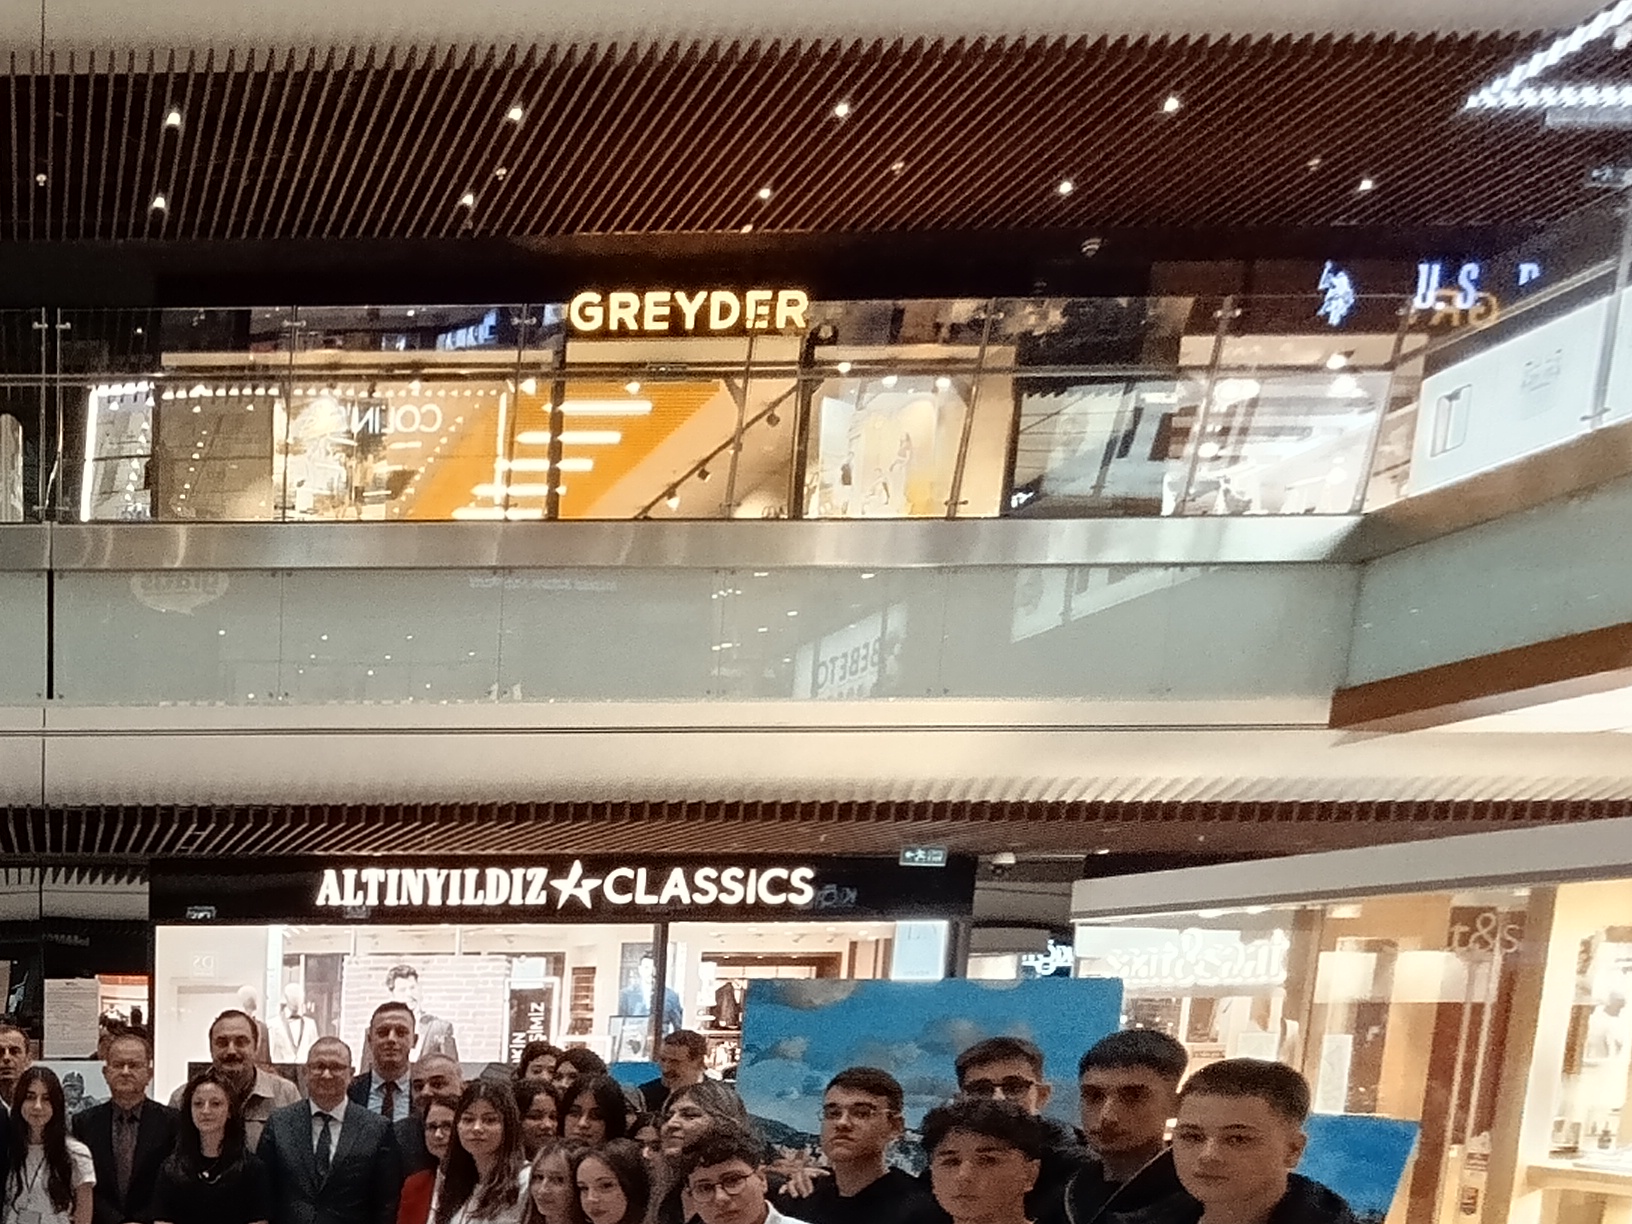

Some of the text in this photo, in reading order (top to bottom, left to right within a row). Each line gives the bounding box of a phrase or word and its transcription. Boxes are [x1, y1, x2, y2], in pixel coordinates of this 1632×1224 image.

[570, 290, 809, 331] GREYDER
[316, 868, 547, 906] ALTINYILDIZ
[603, 867, 814, 906] CLASSICS
